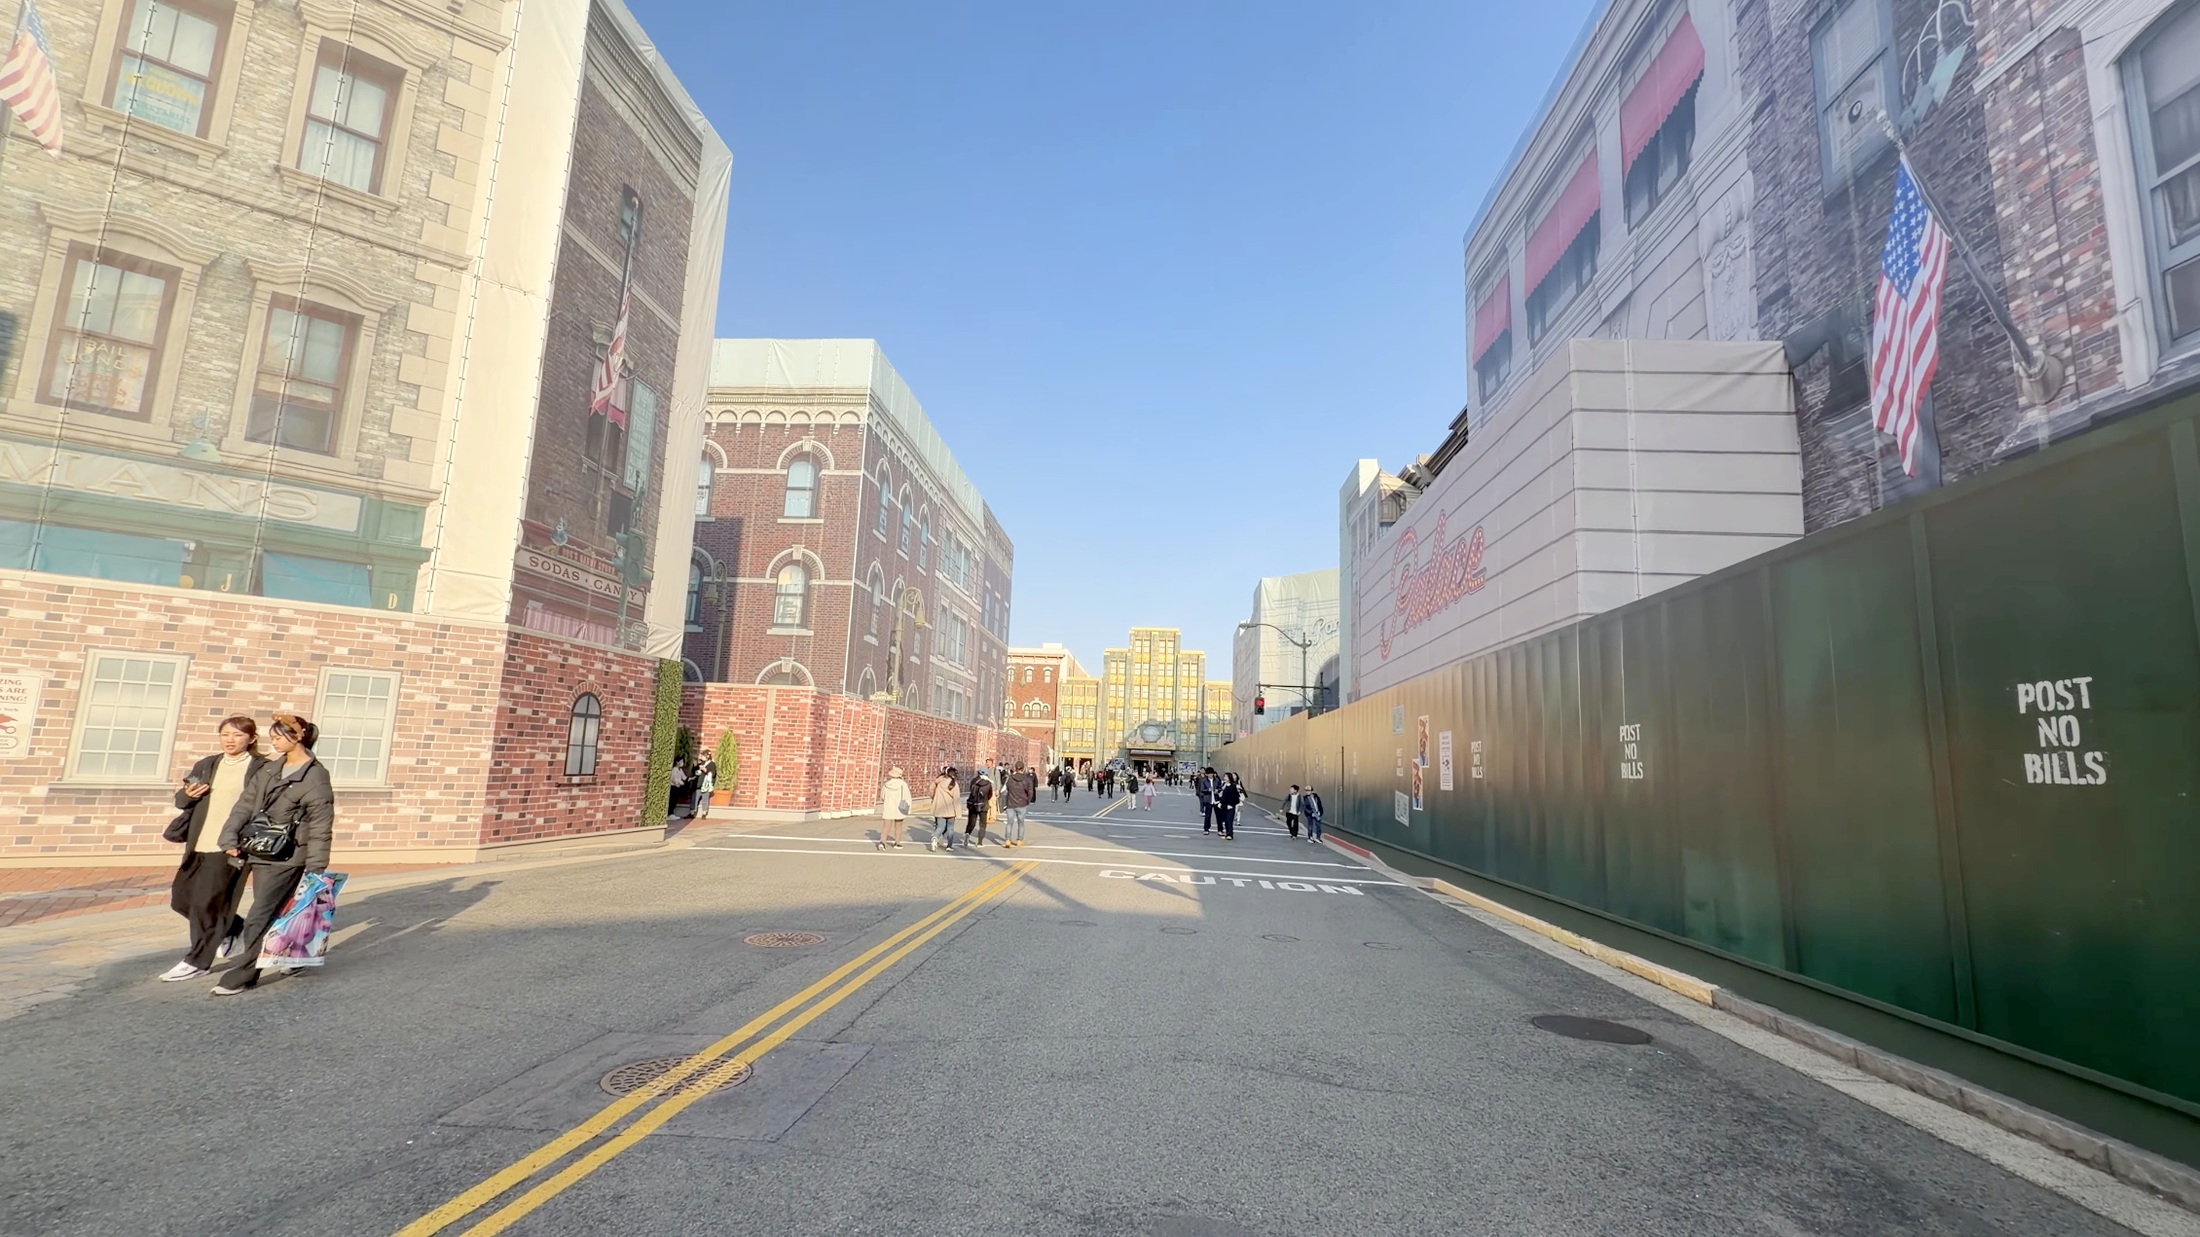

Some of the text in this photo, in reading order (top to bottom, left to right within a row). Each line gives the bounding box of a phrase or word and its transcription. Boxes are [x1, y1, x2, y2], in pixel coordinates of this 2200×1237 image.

[84, 340, 126, 357] BAIL
[529, 556, 580, 582] SODAS
[593, 579, 637, 601] CANY
[1380, 508, 1487, 661] Palace
[2017, 676, 2093, 714] POST
[1619, 724, 1641, 742] POST
[2037, 714, 2081, 748] NO
[1624, 742, 1637, 760] NO
[1621, 761, 1644, 779] BILLS
[2023, 750, 2107, 785] BILLS
[1099, 869, 1365, 896] CAUTION
